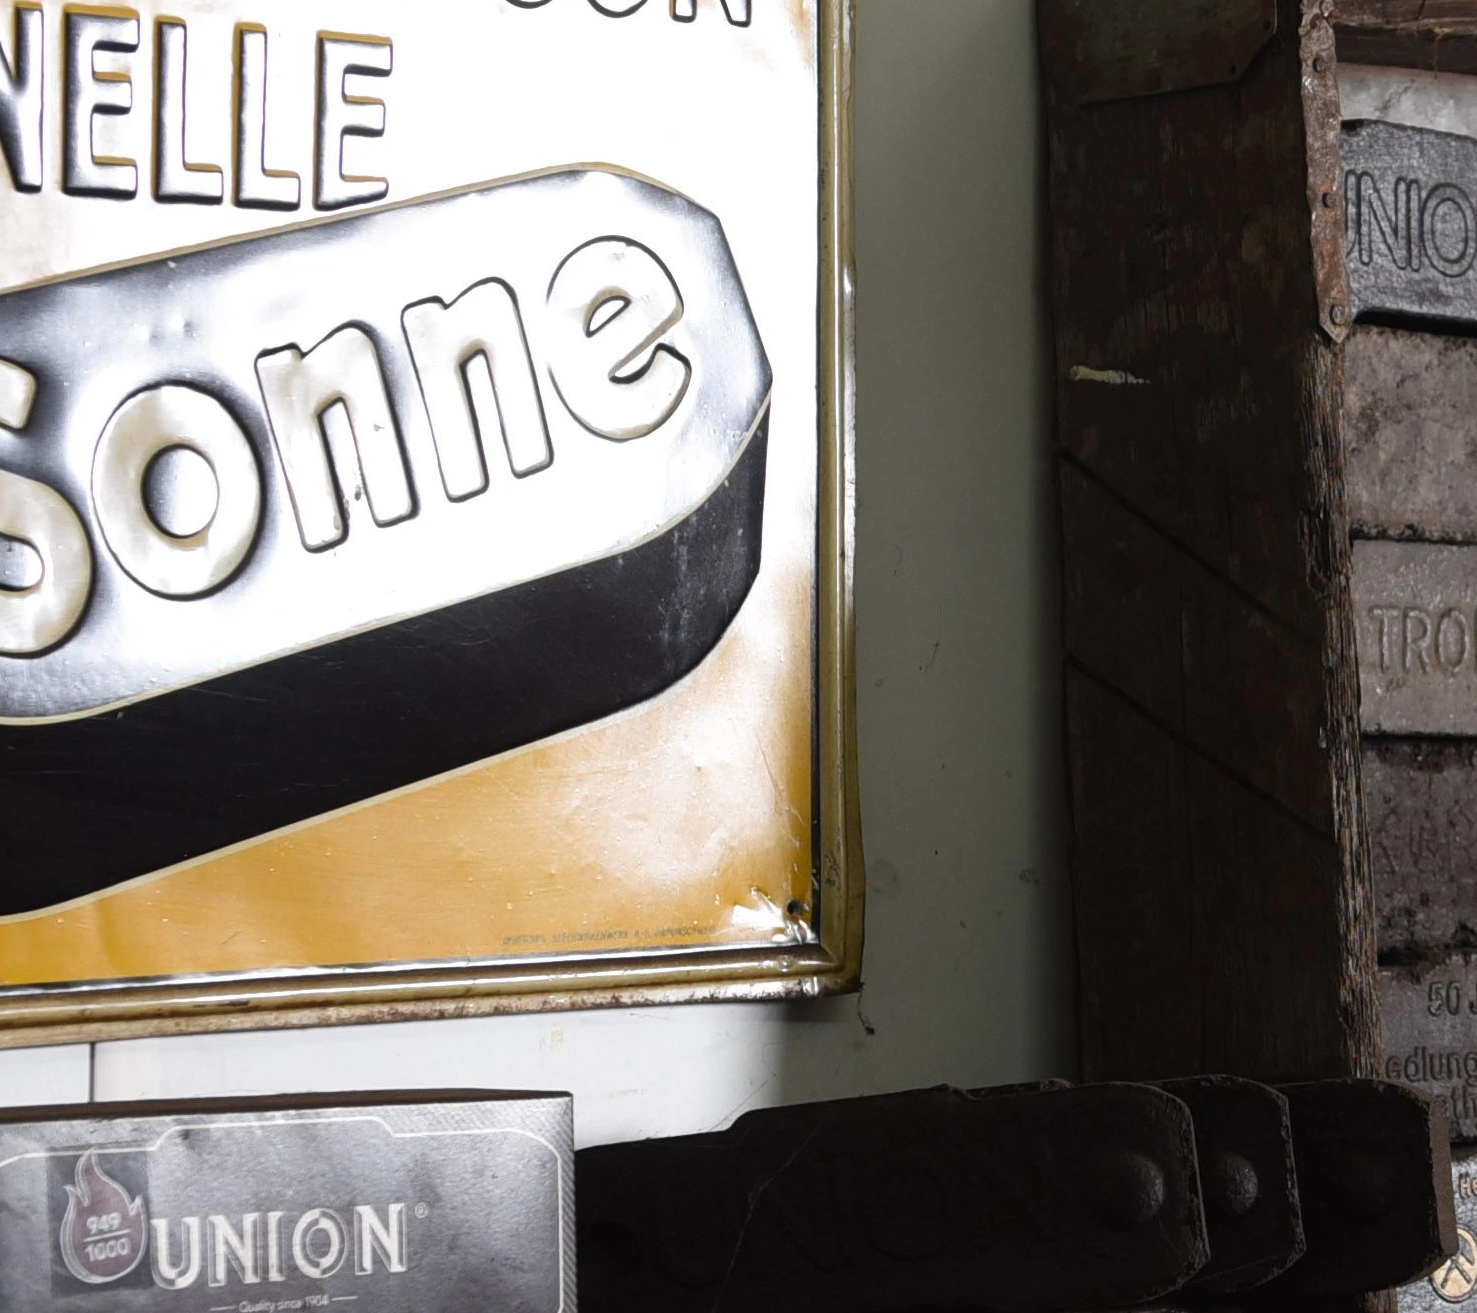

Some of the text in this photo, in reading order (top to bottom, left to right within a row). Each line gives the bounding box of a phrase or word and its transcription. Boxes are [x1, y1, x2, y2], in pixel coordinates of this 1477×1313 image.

[85, 1211, 122, 1232] 949
[84, 1237, 132, 1263] 1000
[150, 1202, 408, 1290] UNION
[239, 1299, 276, 1313] Quality
